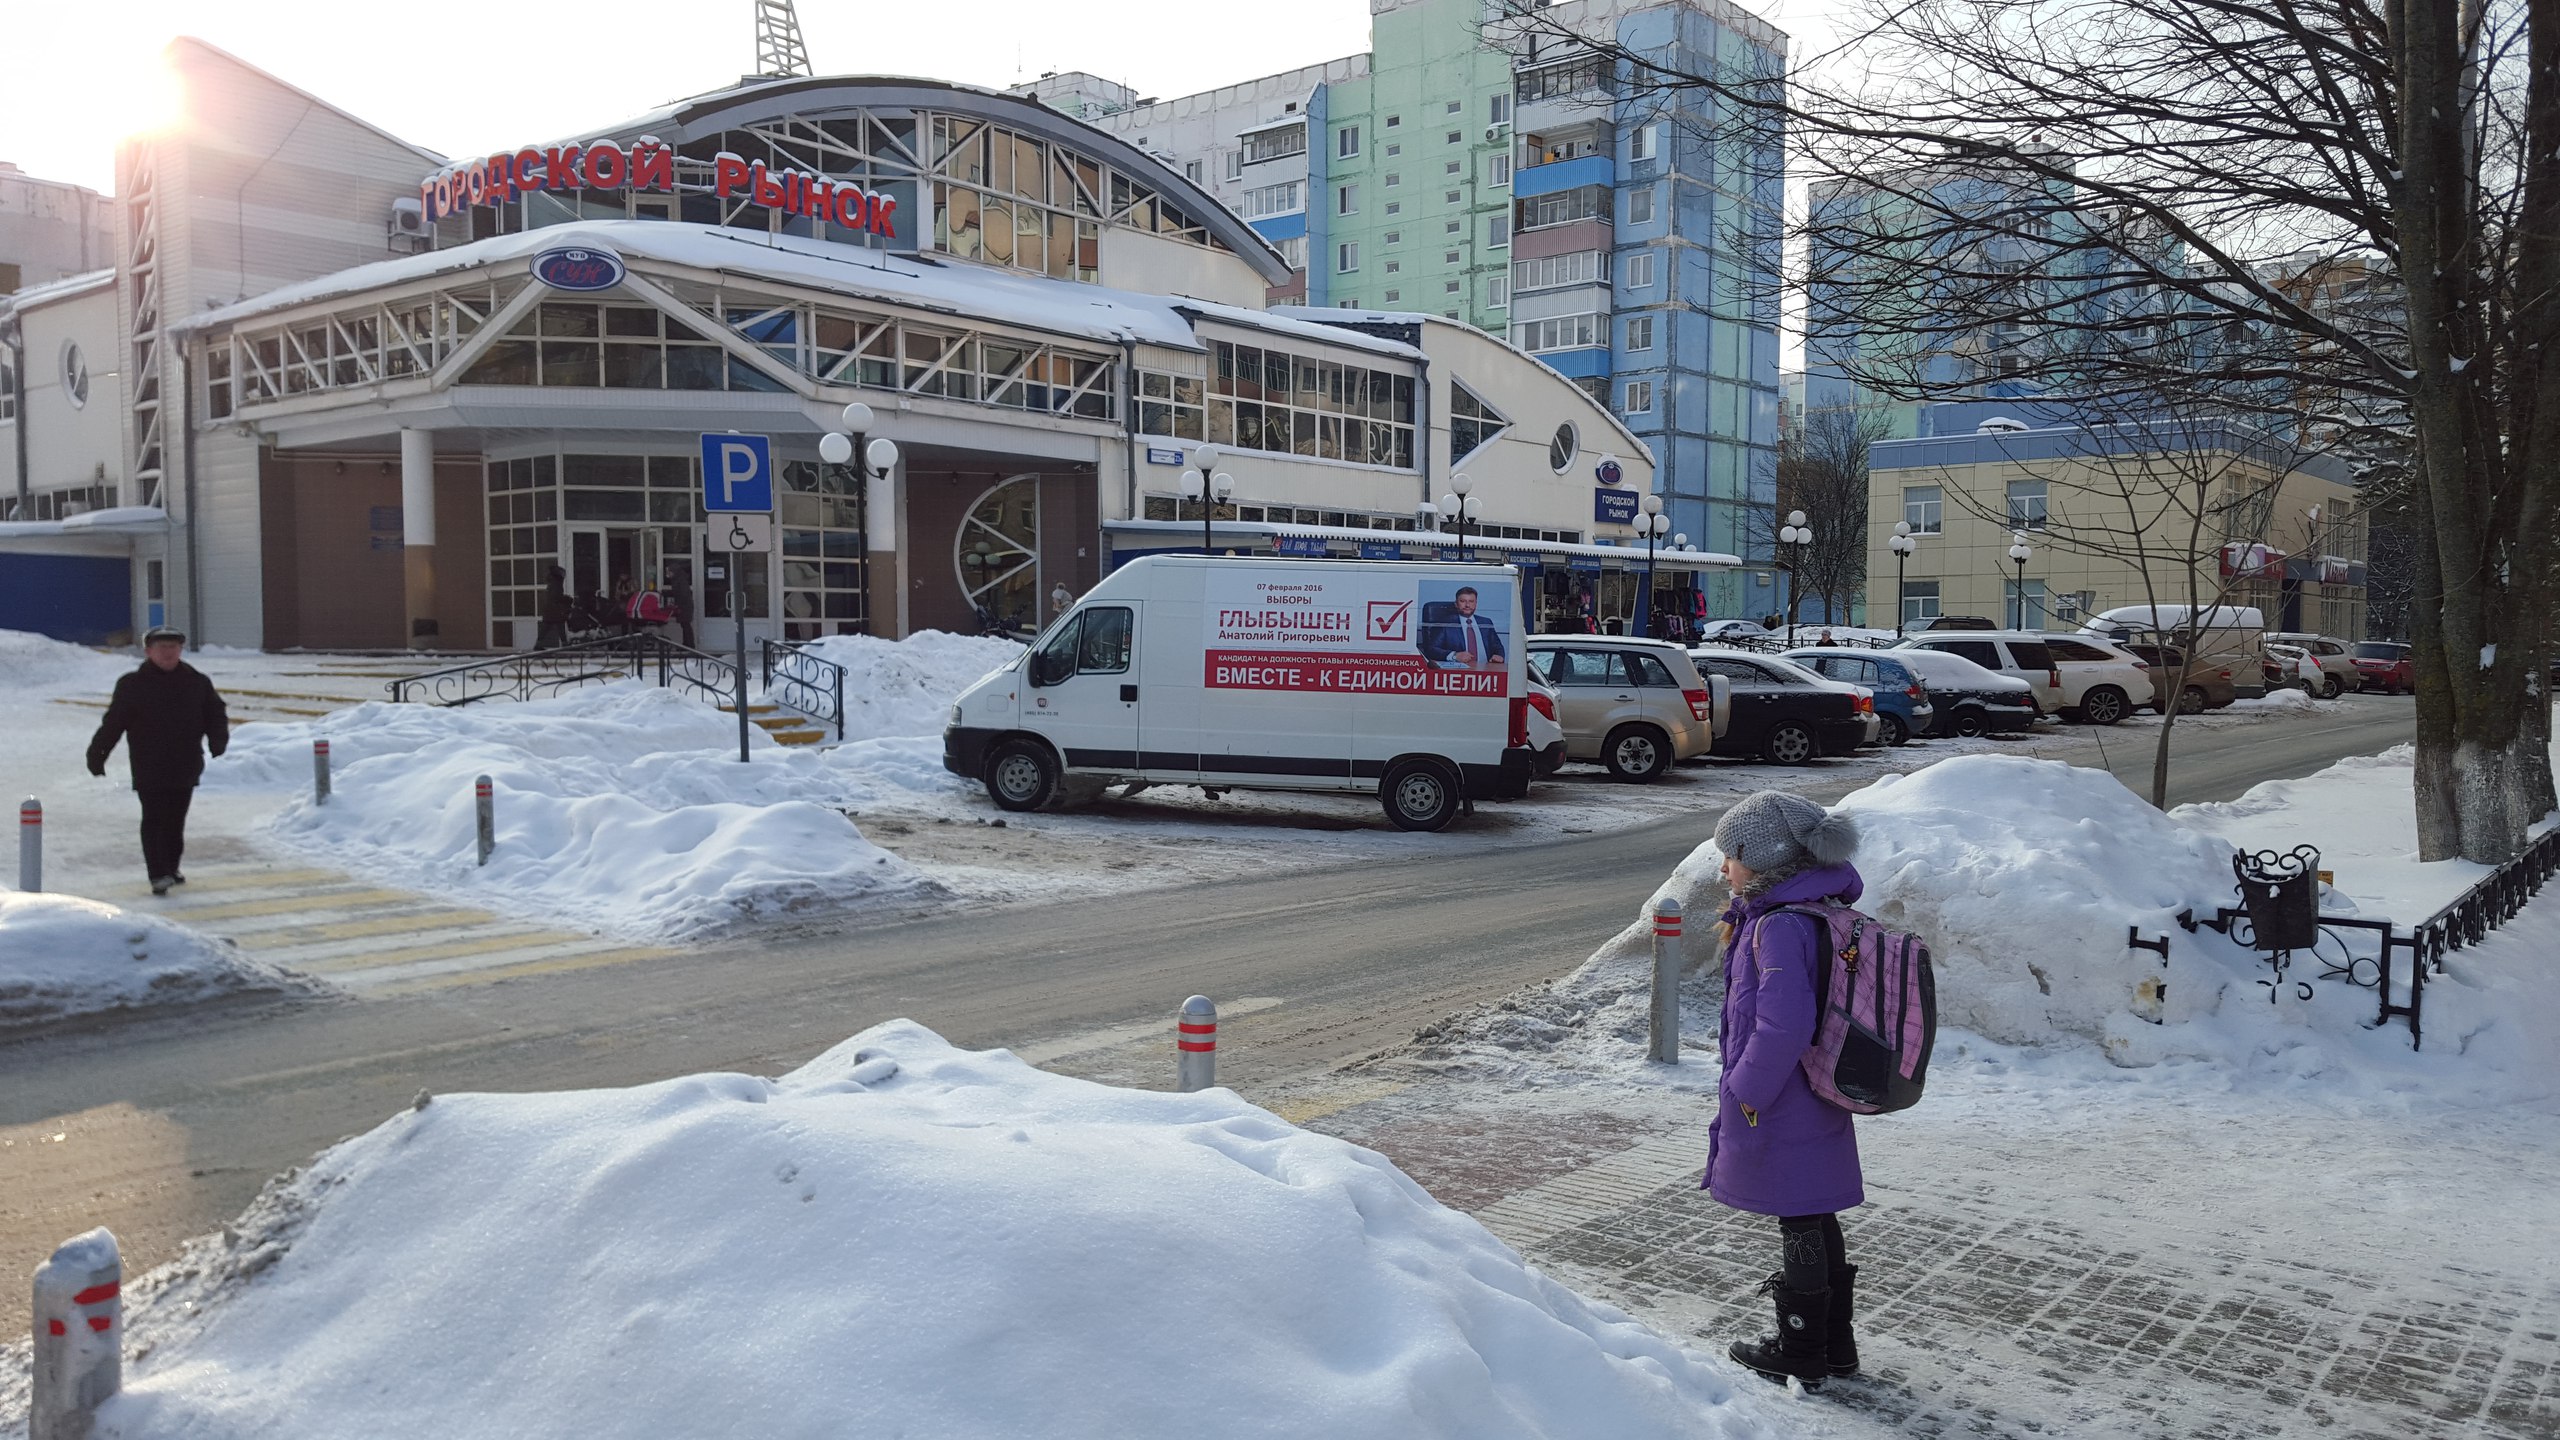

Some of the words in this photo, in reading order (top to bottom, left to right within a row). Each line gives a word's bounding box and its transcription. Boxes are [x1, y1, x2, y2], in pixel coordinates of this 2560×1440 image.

[420, 136, 673, 224] ГОРОДСКОЙ
[714, 152, 897, 239] РЫНОК
[1602, 495, 1635, 507] ГОРОДСКОЙ
[1608, 508, 1629, 519] РЫНОК
[1442, 550, 1473, 560] ПОДАКИ
[1509, 555, 1539, 564] КОСМЕТИКА
[1256, 583, 1266, 591] 07
[1268, 584, 1302, 592] февраля
[1266, 595, 1312, 605] ВЫБОРЫ
[1219, 610, 1350, 630] ГЛЫБЫШЕН
[1218, 630, 1274, 641] Анатолий
[1278, 631, 1350, 644] Григорьевич
[1218, 654, 1256, 663] КАНДИДАТ
[1269, 656, 1316, 664] ДОЛЖНОСТЬ
[1317, 657, 1344, 665] ГЛАВЫ
[1345, 658, 1420, 667] КРАСНОЗНАМЕНСКА
[1216, 667, 1301, 686] ВМЕСТЕ
[1320, 669, 1333, 687] К
[1338, 668, 1427, 691] ЕДИНОЙ
[1433, 673, 1498, 694] ЦЕЛИ!
